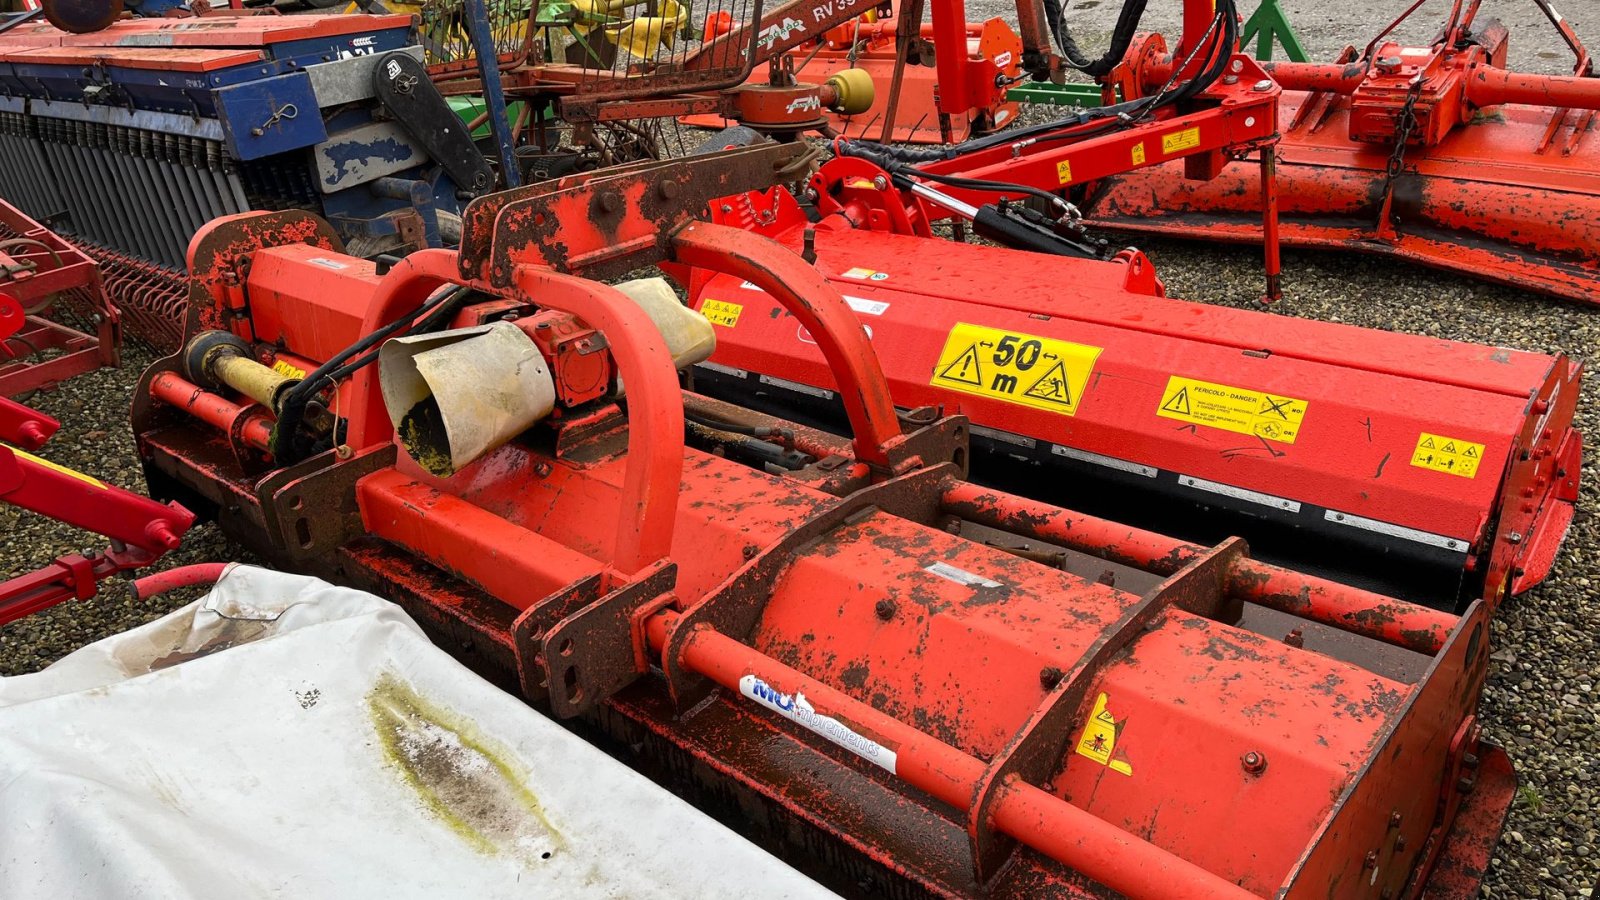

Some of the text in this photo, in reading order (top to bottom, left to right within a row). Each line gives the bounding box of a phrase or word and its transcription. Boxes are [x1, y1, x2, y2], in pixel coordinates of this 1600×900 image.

[813, 1, 833, 22] RV
[993, 335, 1042, 371] 50
[991, 372, 1018, 394] m
[1194, 387, 1225, 397] PERICOLO
[1230, 393, 1257, 403] DANGER
[790, 706, 880, 757] mplements
